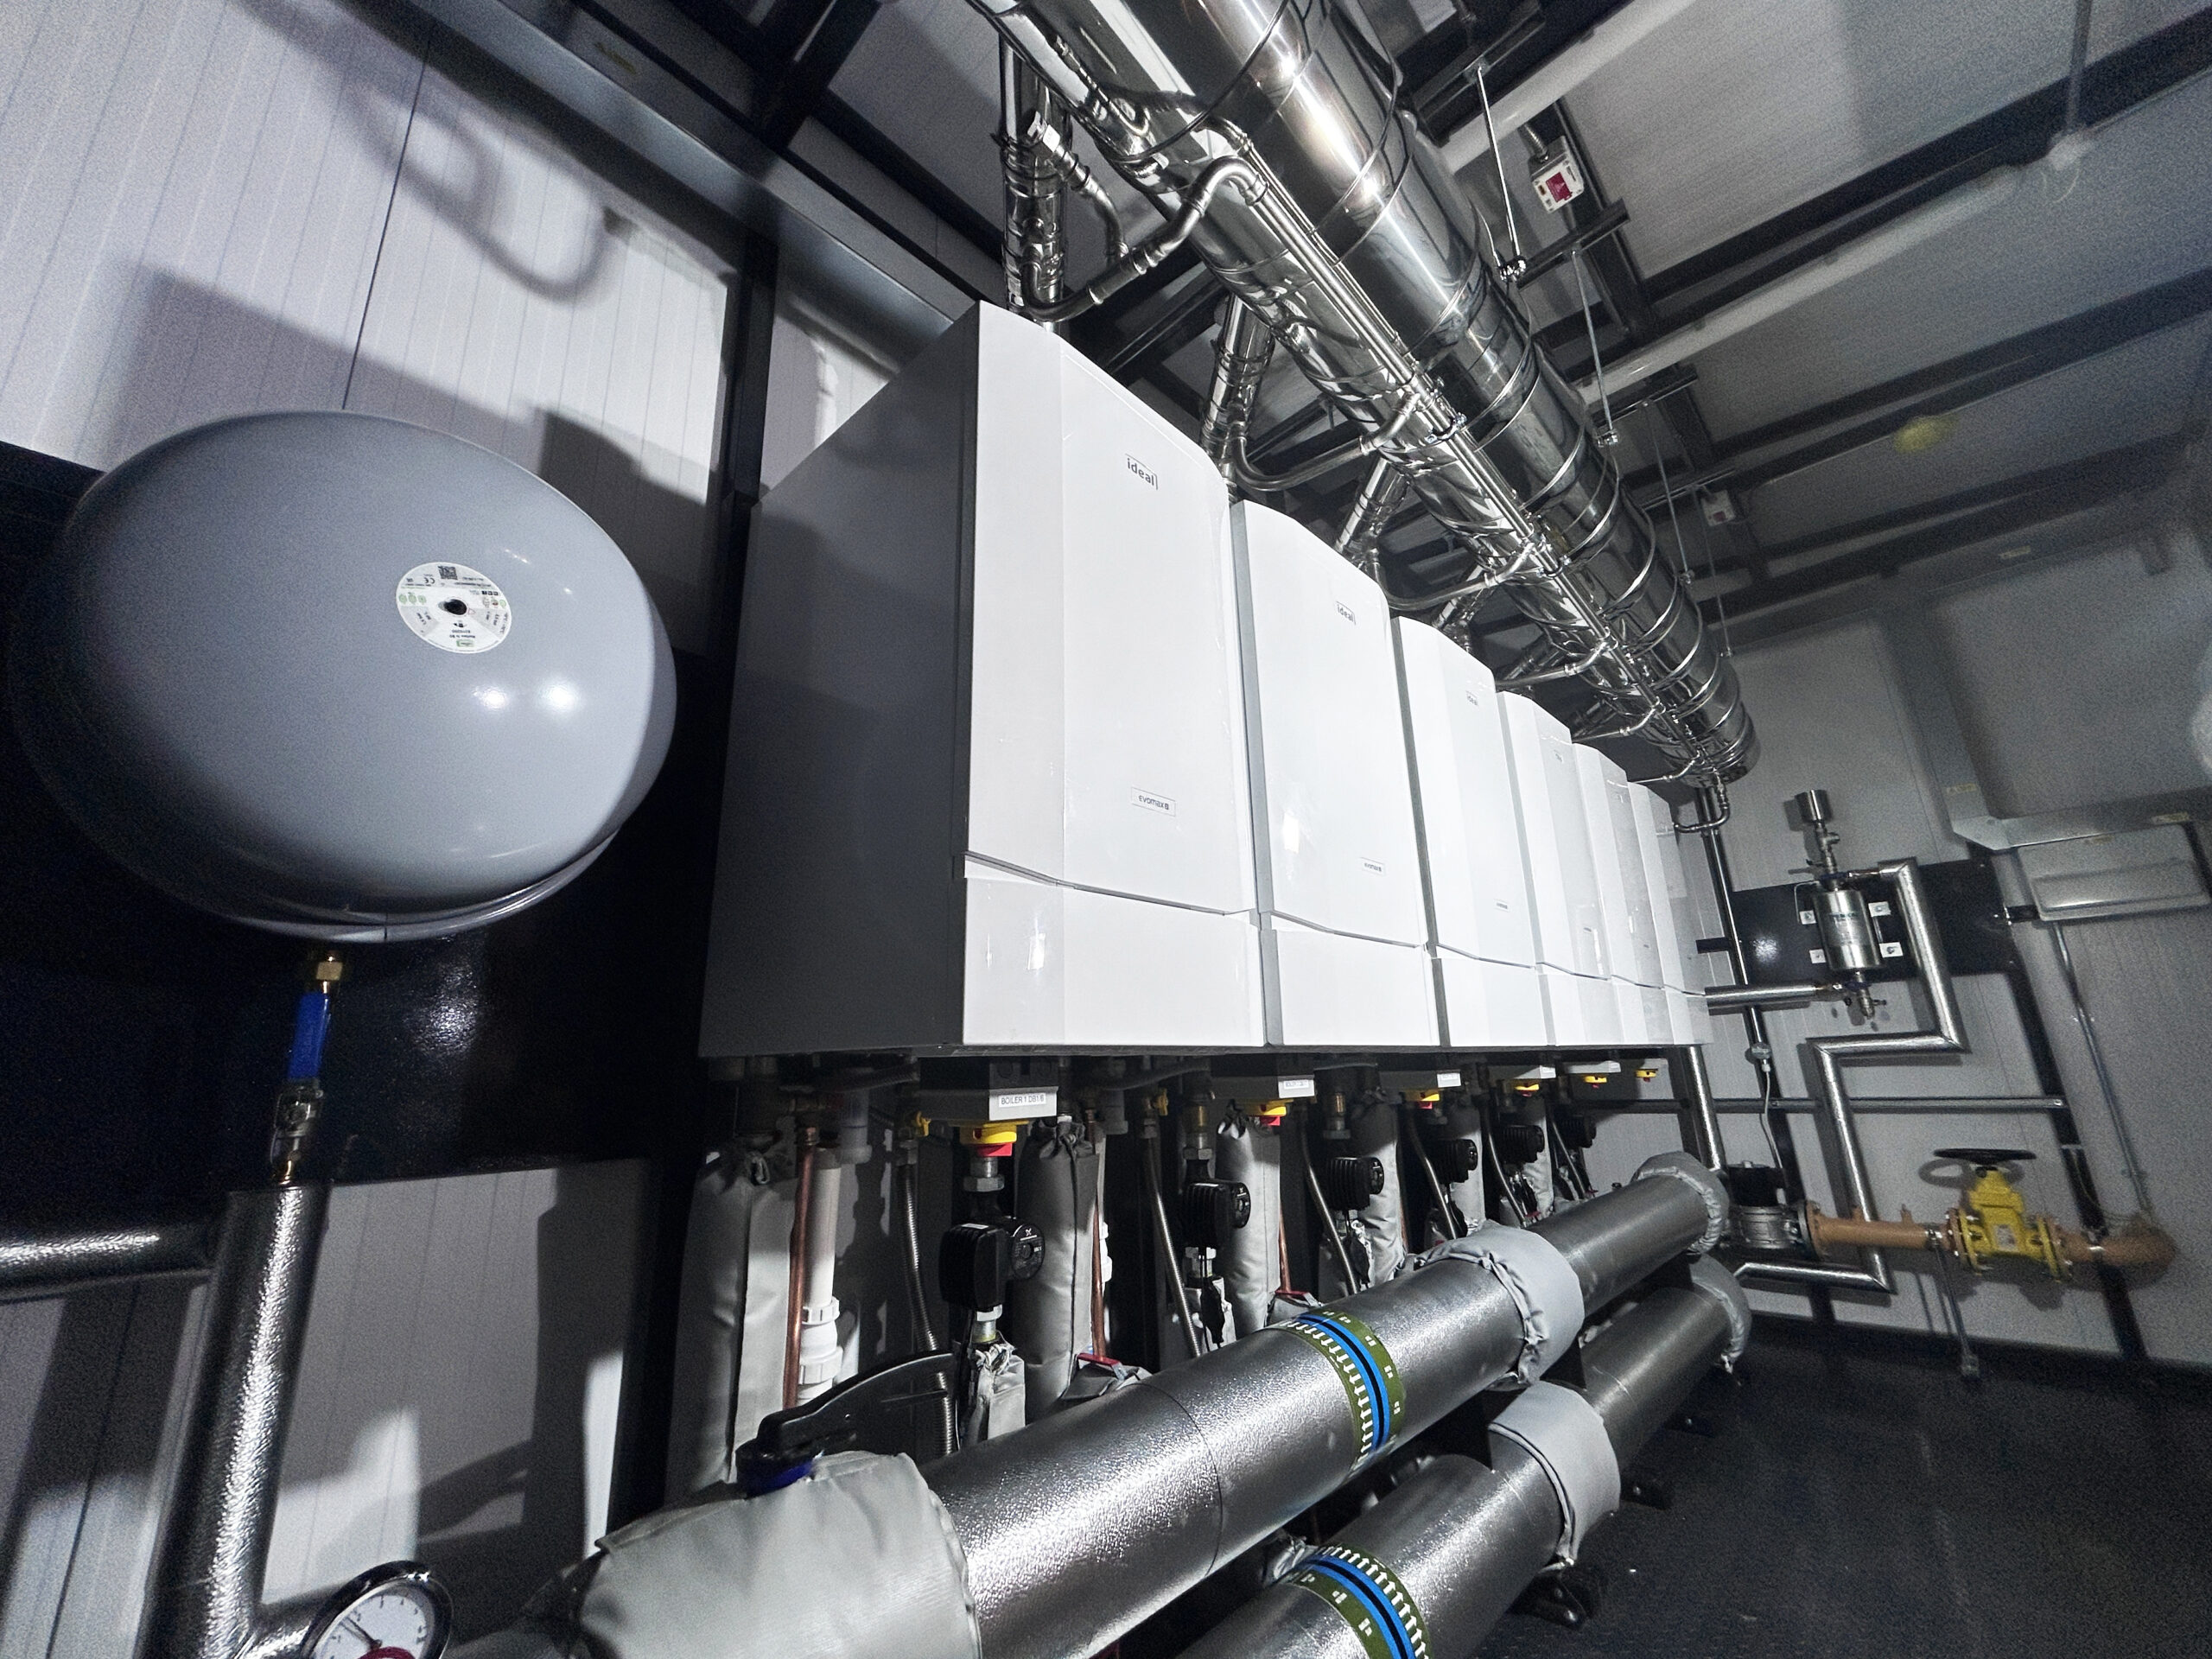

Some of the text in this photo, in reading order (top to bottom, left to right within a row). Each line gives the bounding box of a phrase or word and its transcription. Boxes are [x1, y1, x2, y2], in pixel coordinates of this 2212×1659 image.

[1127, 457, 1154, 486] ideal
[1337, 604, 1354, 622] ideal
[1001, 1096, 1023, 1105] BOILER
